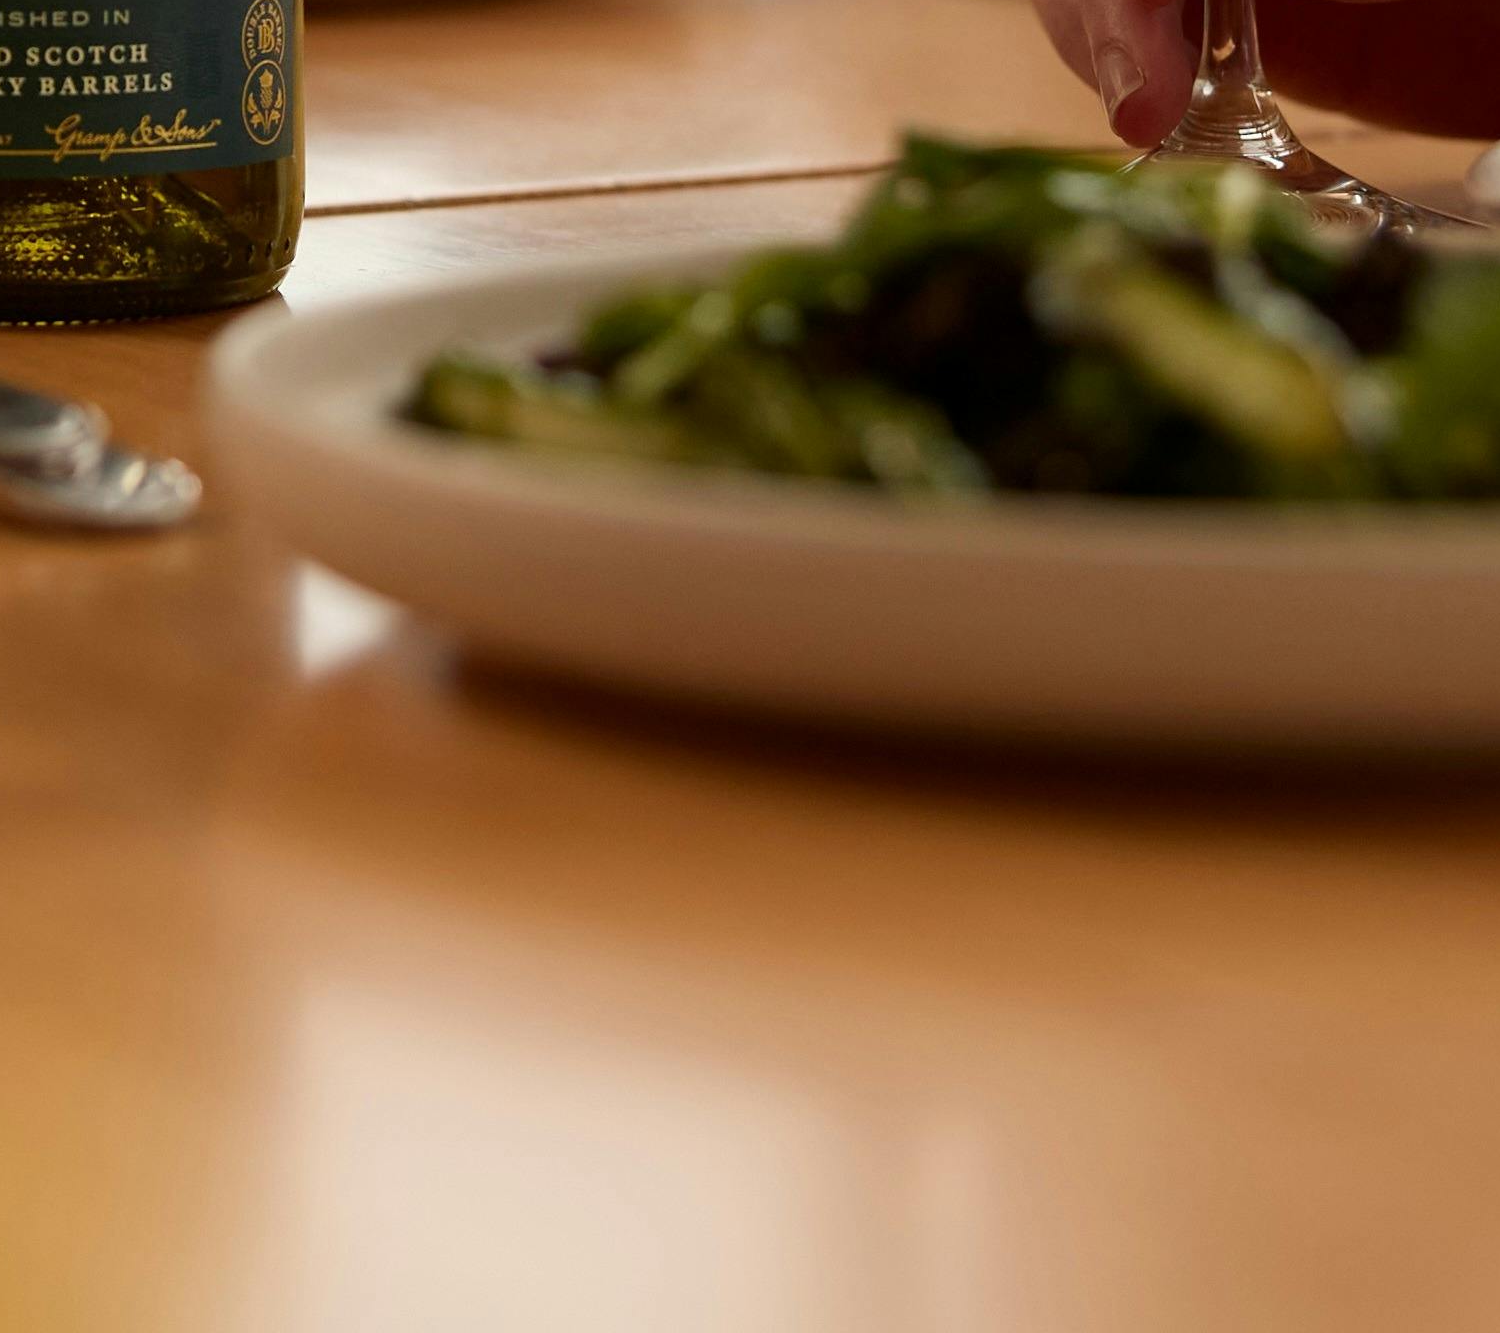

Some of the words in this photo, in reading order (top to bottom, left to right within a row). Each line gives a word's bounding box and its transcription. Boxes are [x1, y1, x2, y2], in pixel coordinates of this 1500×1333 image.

[102, 9, 131, 26] IN
[24, 43, 150, 67] SCOTCH
[38, 71, 174, 97] BARRELS
